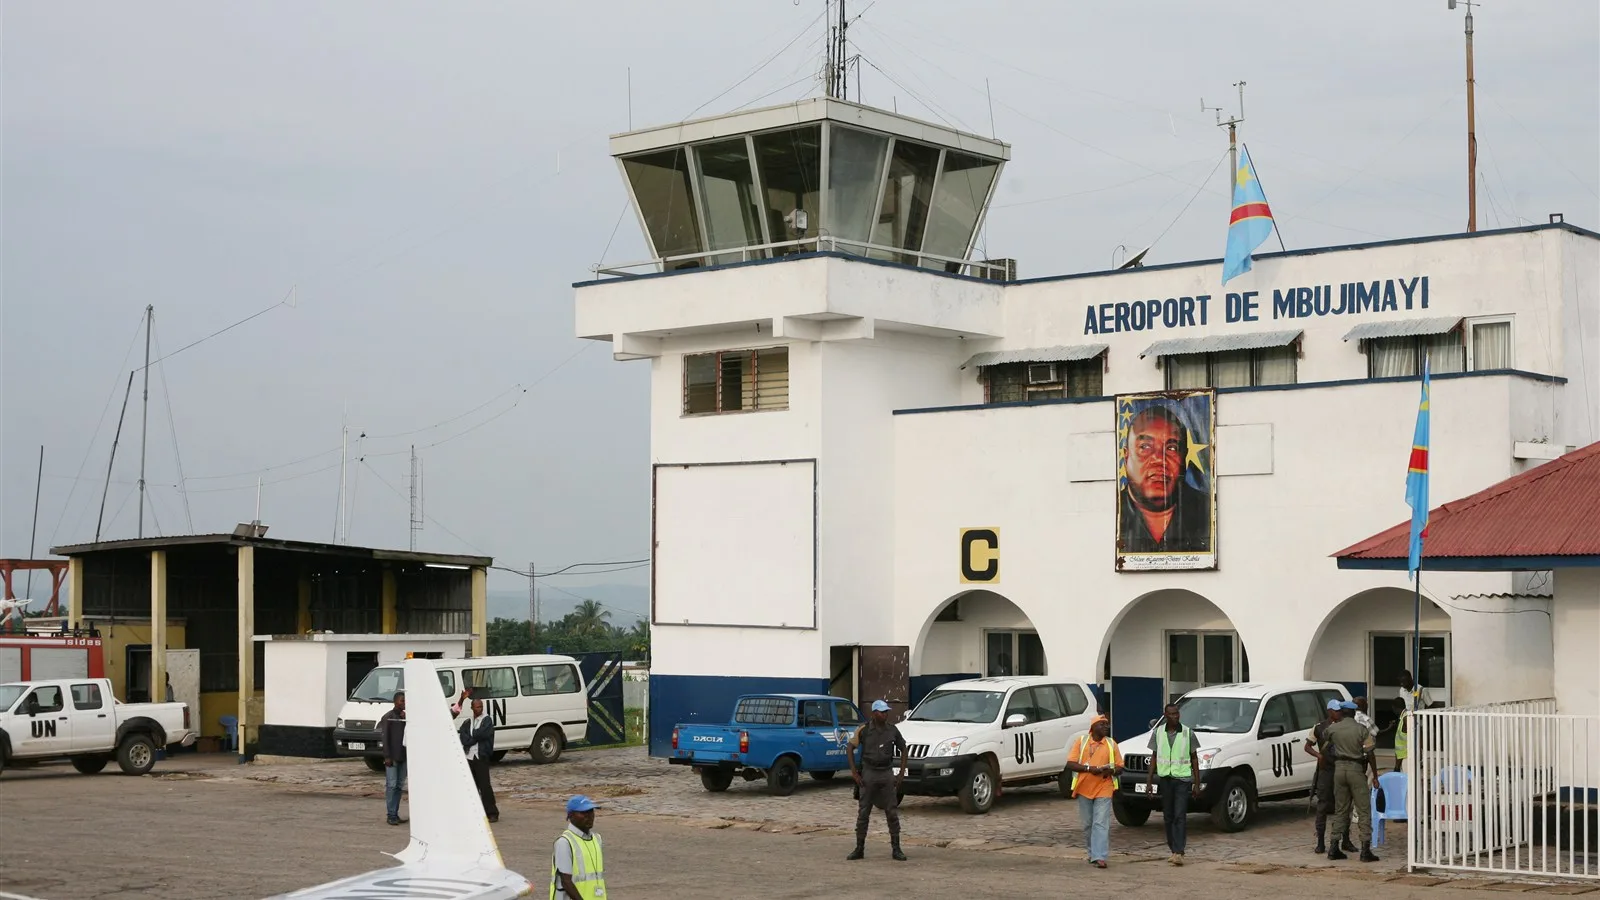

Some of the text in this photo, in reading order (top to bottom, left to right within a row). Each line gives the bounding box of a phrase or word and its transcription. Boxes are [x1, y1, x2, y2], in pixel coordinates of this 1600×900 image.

[1084, 276, 1429, 335] AEROPORT DE MBUJIMAYI
[961, 529, 998, 581] C
[67, 638, 101, 646] sides
[31, 720, 57, 737] UN
[1014, 732, 1035, 764] UN
[1271, 742, 1294, 777] UN
